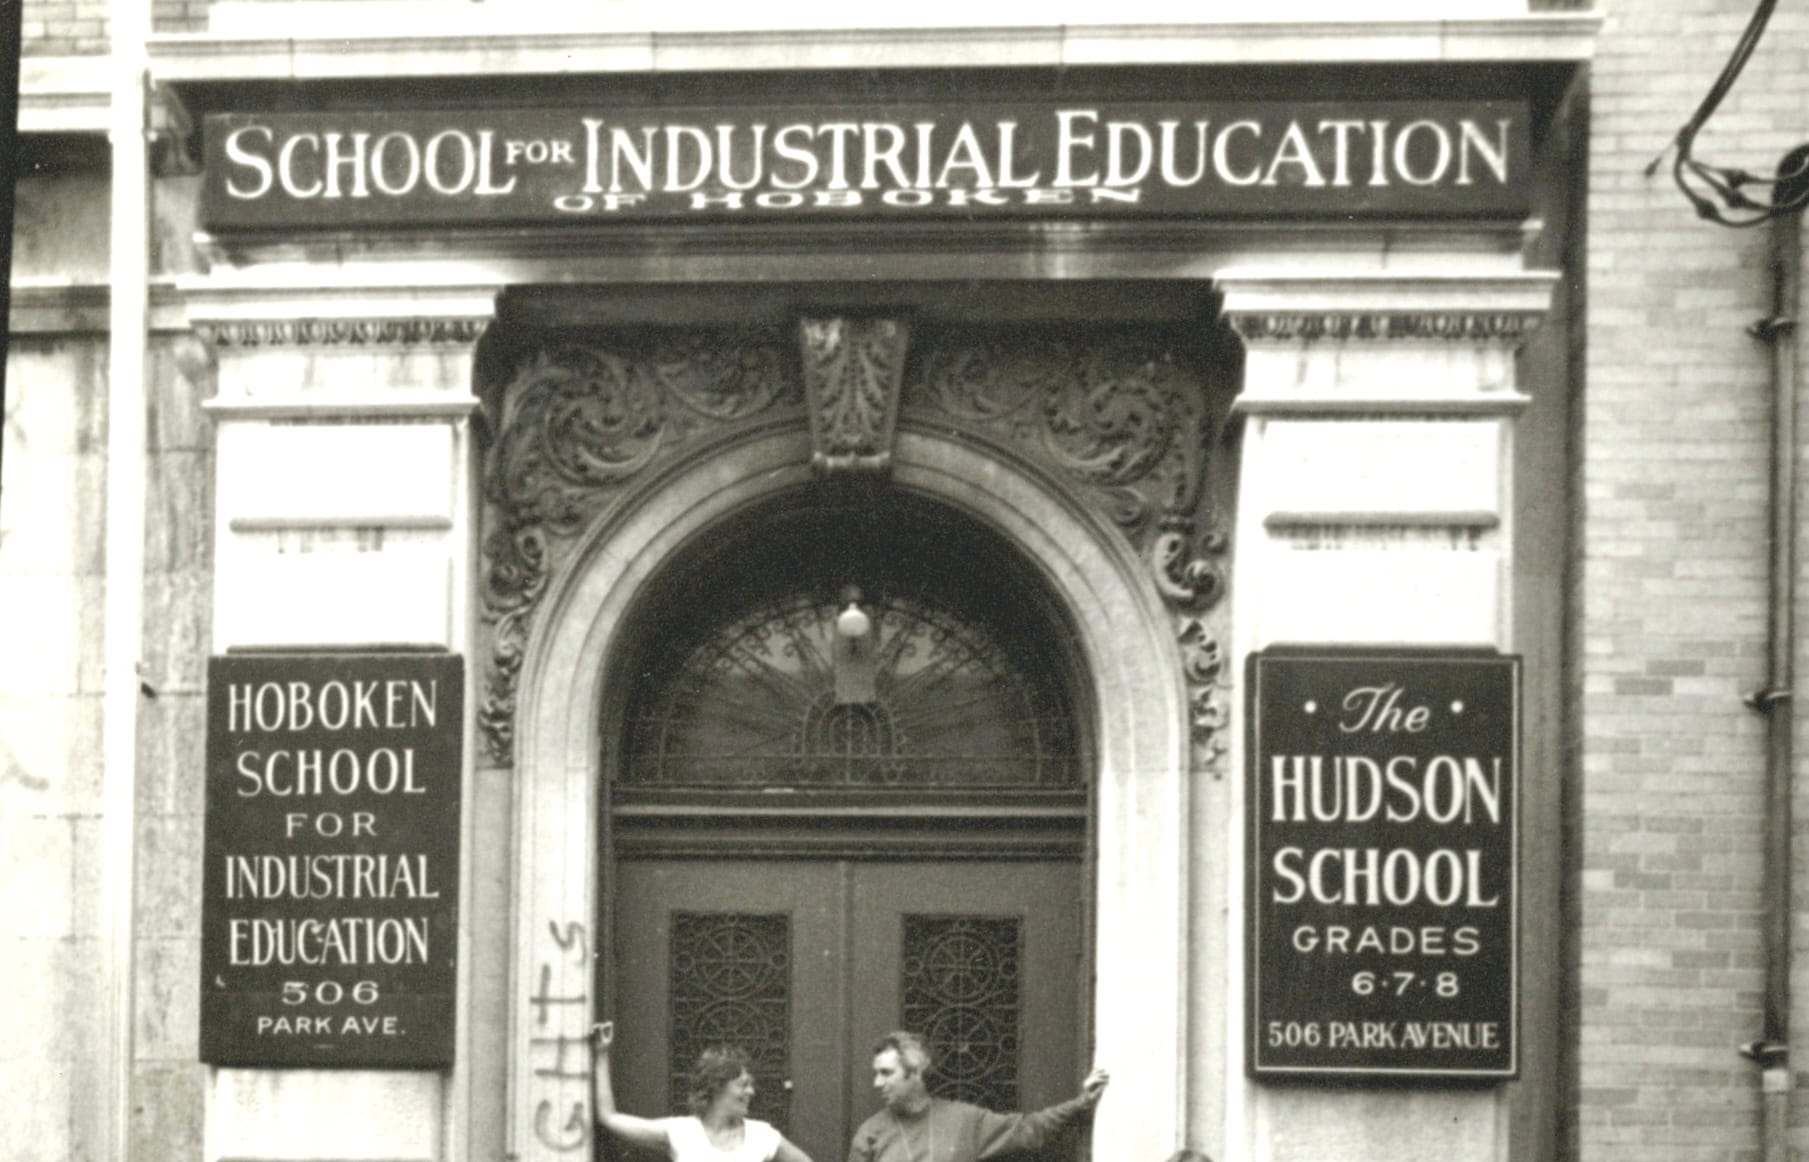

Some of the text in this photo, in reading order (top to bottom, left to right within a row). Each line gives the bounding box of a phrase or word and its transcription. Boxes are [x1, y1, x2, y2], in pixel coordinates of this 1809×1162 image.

[224, 109, 1511, 199] SCHOOL FOR INDUSTRIAL EDUCATION
[553, 187, 1141, 212] OF HOBOKEN
[228, 680, 437, 732] HOBOKEN
[1337, 683, 1430, 733] The
[236, 748, 427, 796] SCHOOL
[1271, 755, 1501, 823] HUDSON
[286, 811, 378, 838] FOR
[226, 854, 440, 899] INDUSTRIAL
[1273, 846, 1499, 907] SCHOOL
[230, 917, 429, 966] EDUCATION
[1292, 924, 1480, 955] GRADES
[281, 981, 380, 1005] 506
[257, 1015, 333, 1035] PARK
[1268, 1021, 1499, 1049] 506 PARK AVENUE
